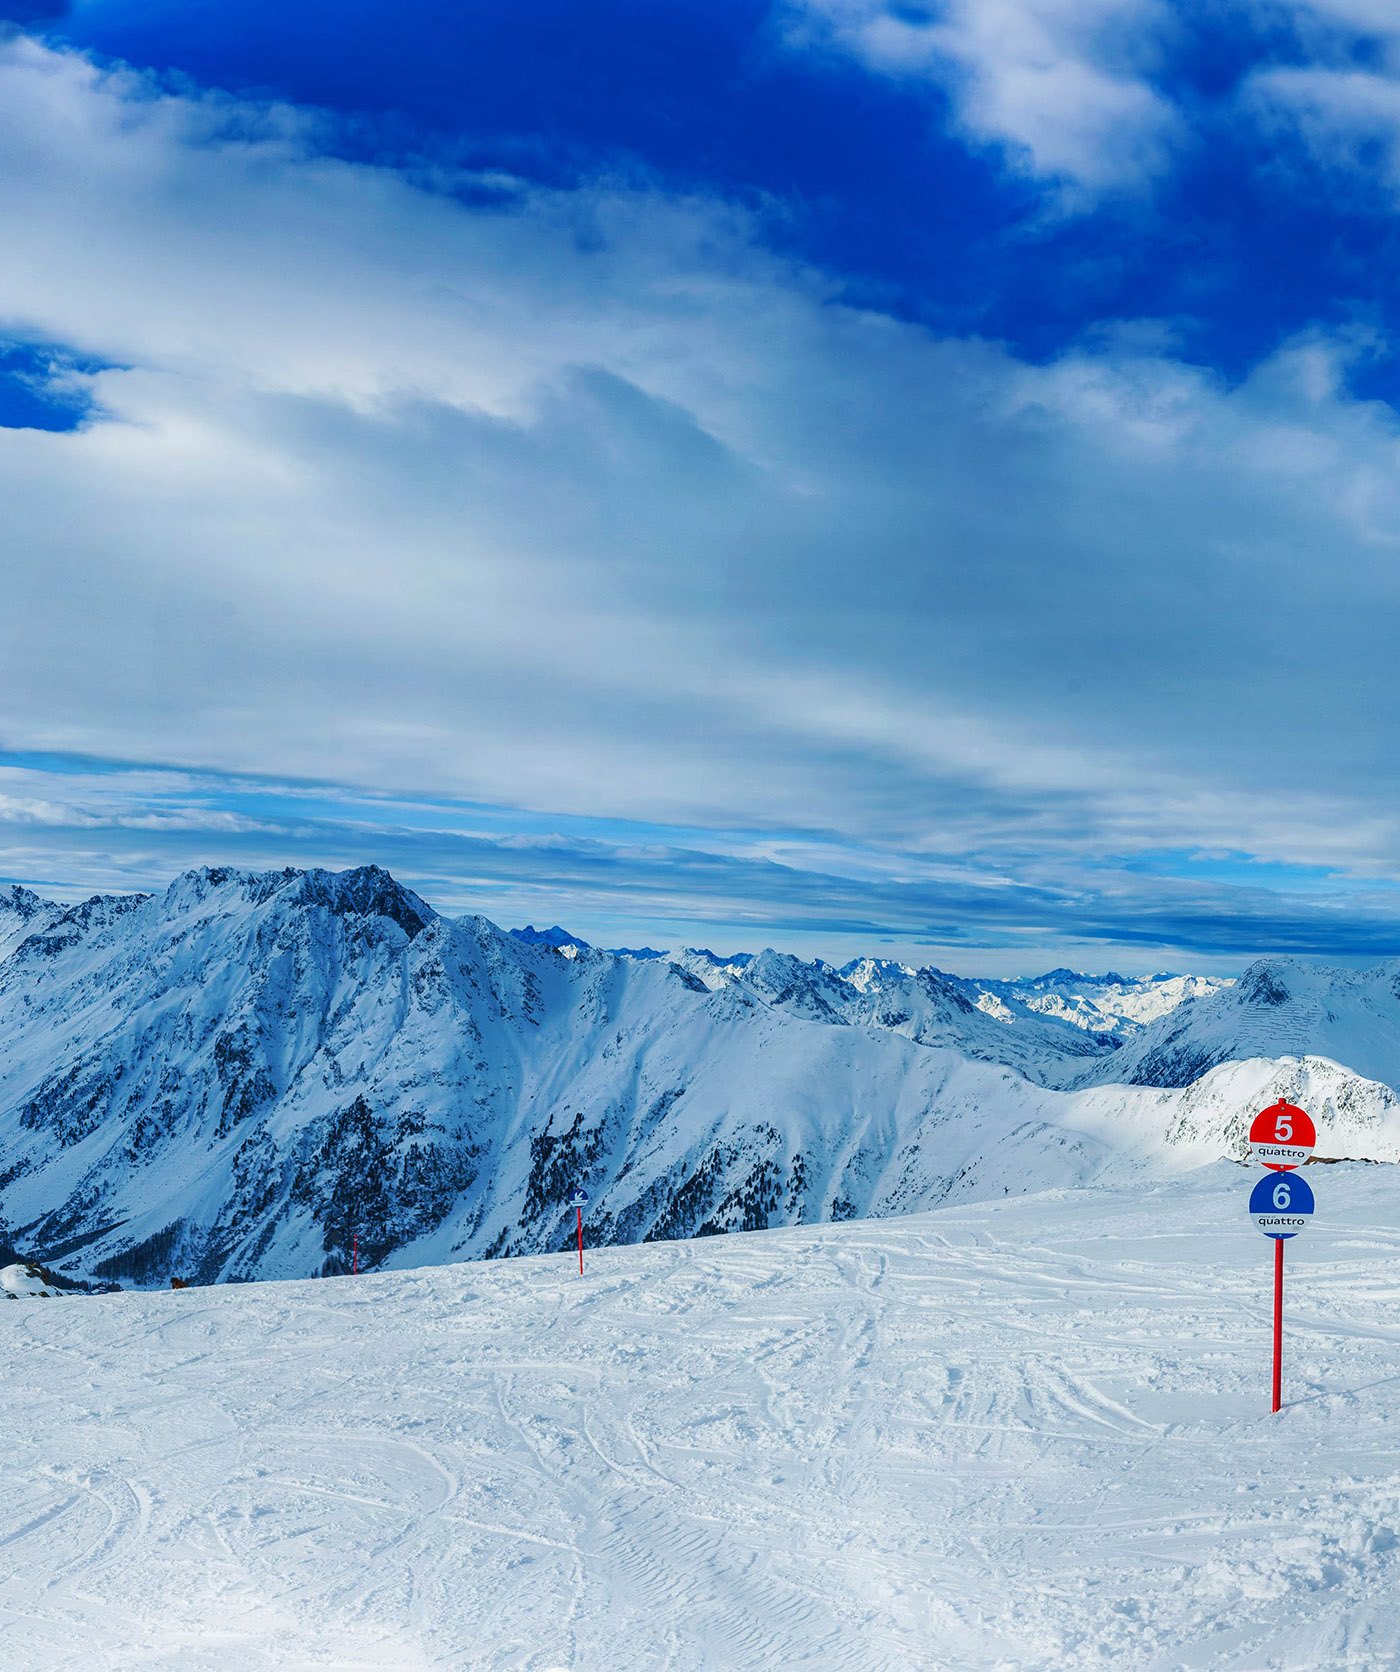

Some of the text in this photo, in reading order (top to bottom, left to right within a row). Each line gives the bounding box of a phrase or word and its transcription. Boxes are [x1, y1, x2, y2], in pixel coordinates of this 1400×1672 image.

[1273, 1115, 1294, 1142] 5
[1258, 1147, 1305, 1158] quattro
[1272, 1182, 1291, 1210] 6
[1258, 1218, 1305, 1227] quattro
